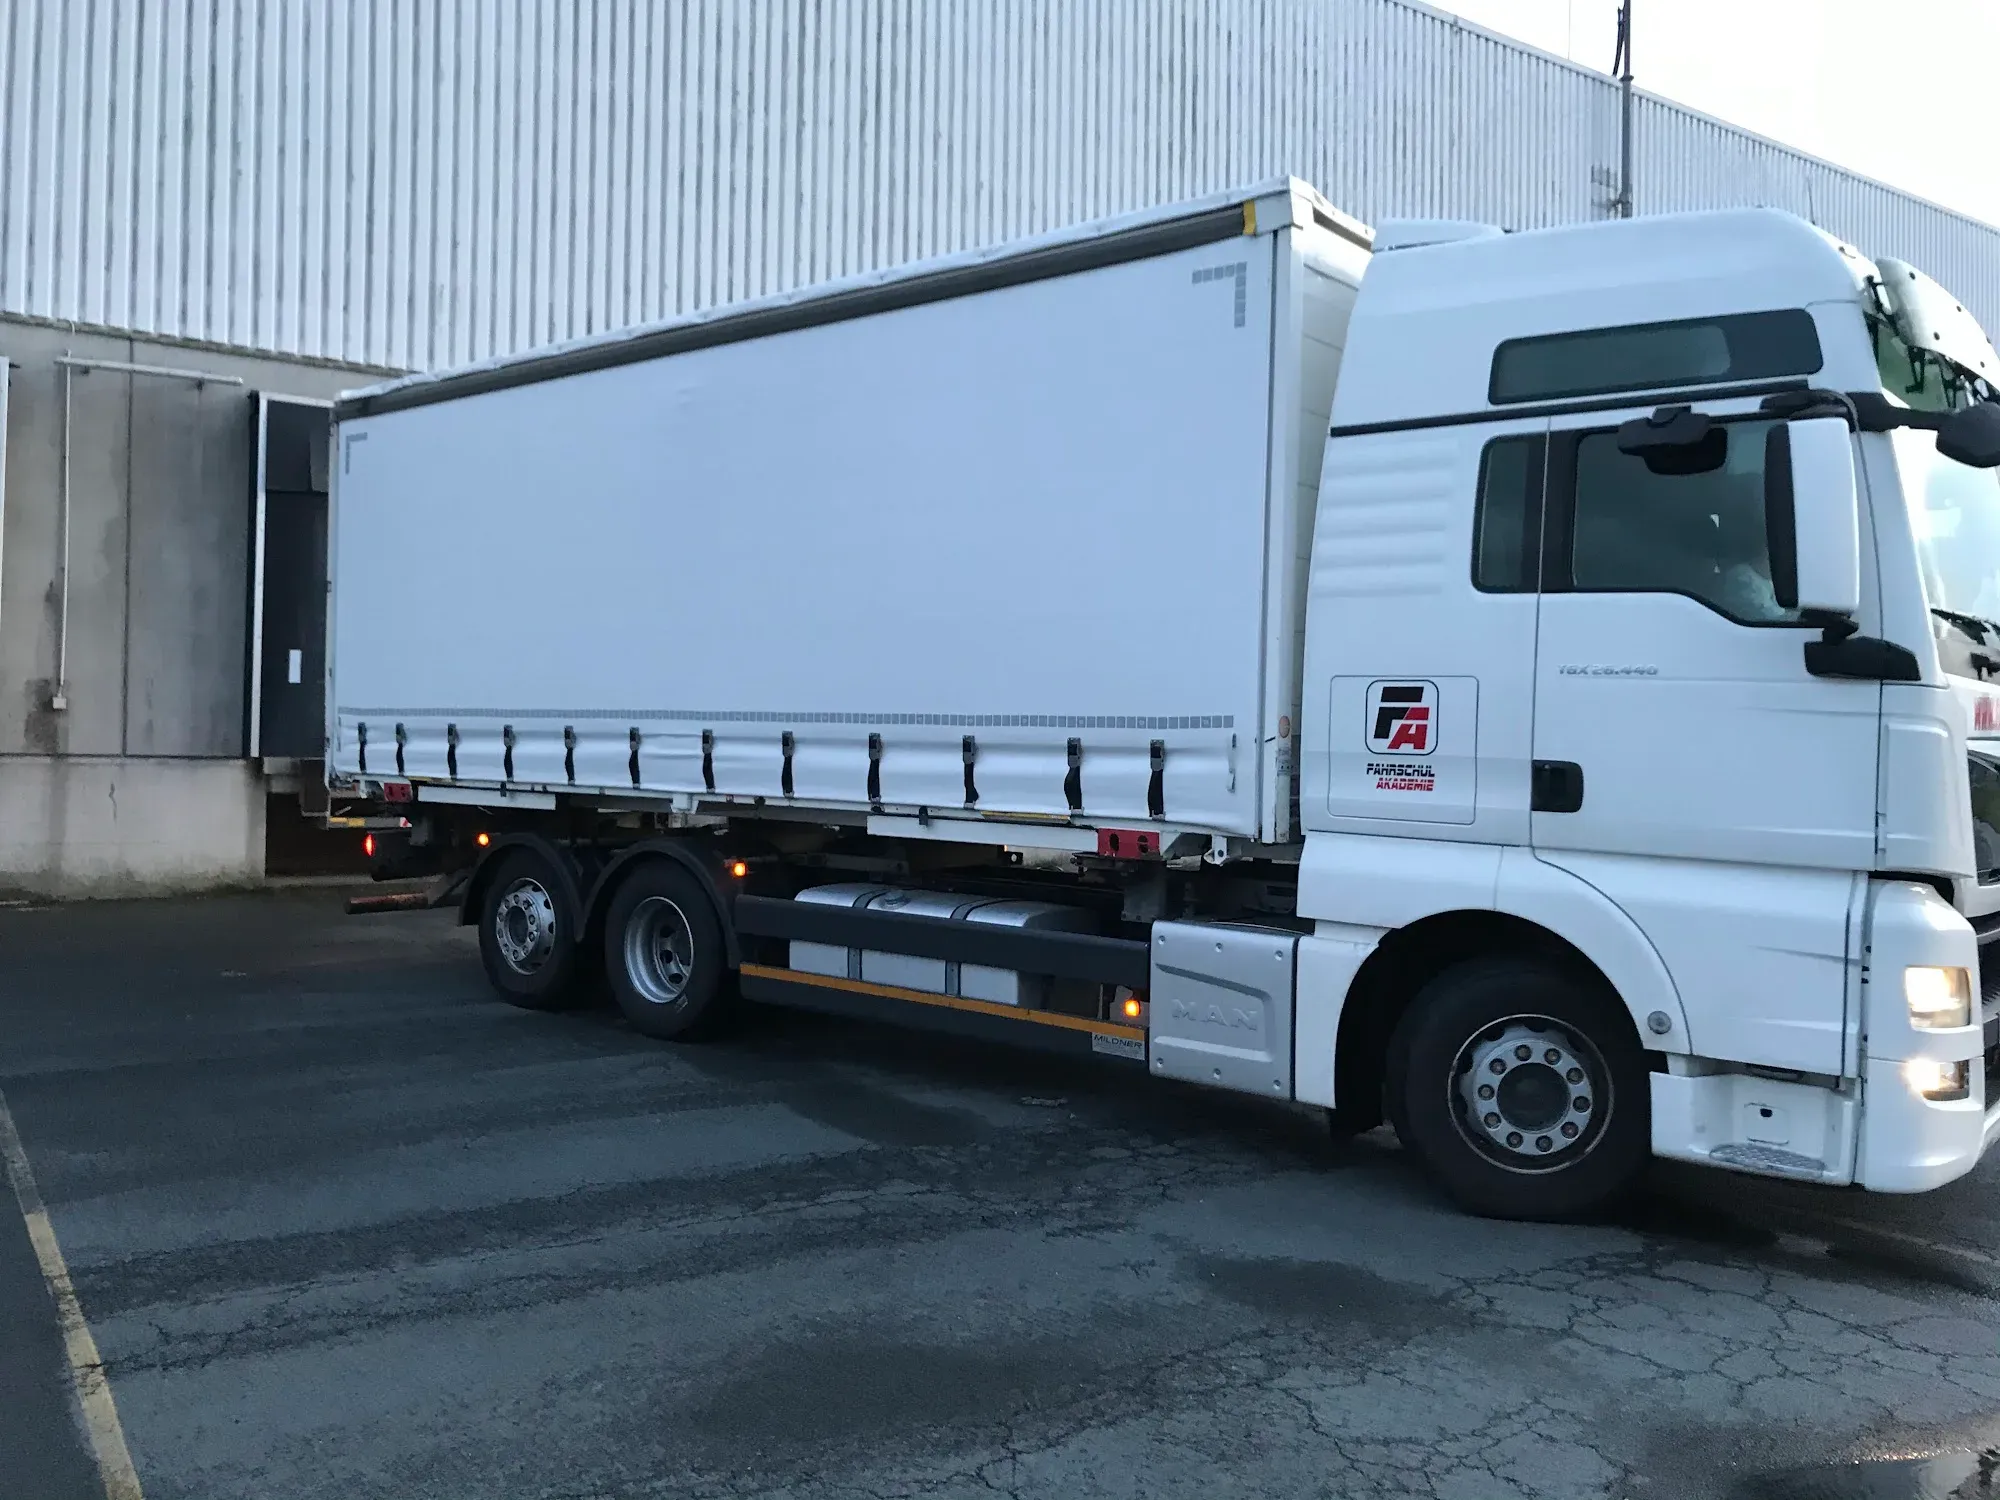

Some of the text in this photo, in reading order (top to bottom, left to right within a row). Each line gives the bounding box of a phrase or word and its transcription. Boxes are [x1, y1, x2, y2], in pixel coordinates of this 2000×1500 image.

[1373, 686, 1430, 750] FA
[1366, 763, 1435, 778] FAHRSCHUL
[1376, 778, 1435, 792] AKADEMIE
[1171, 999, 1257, 1031] MAN
[1094, 1034, 1142, 1049] MILDNER
